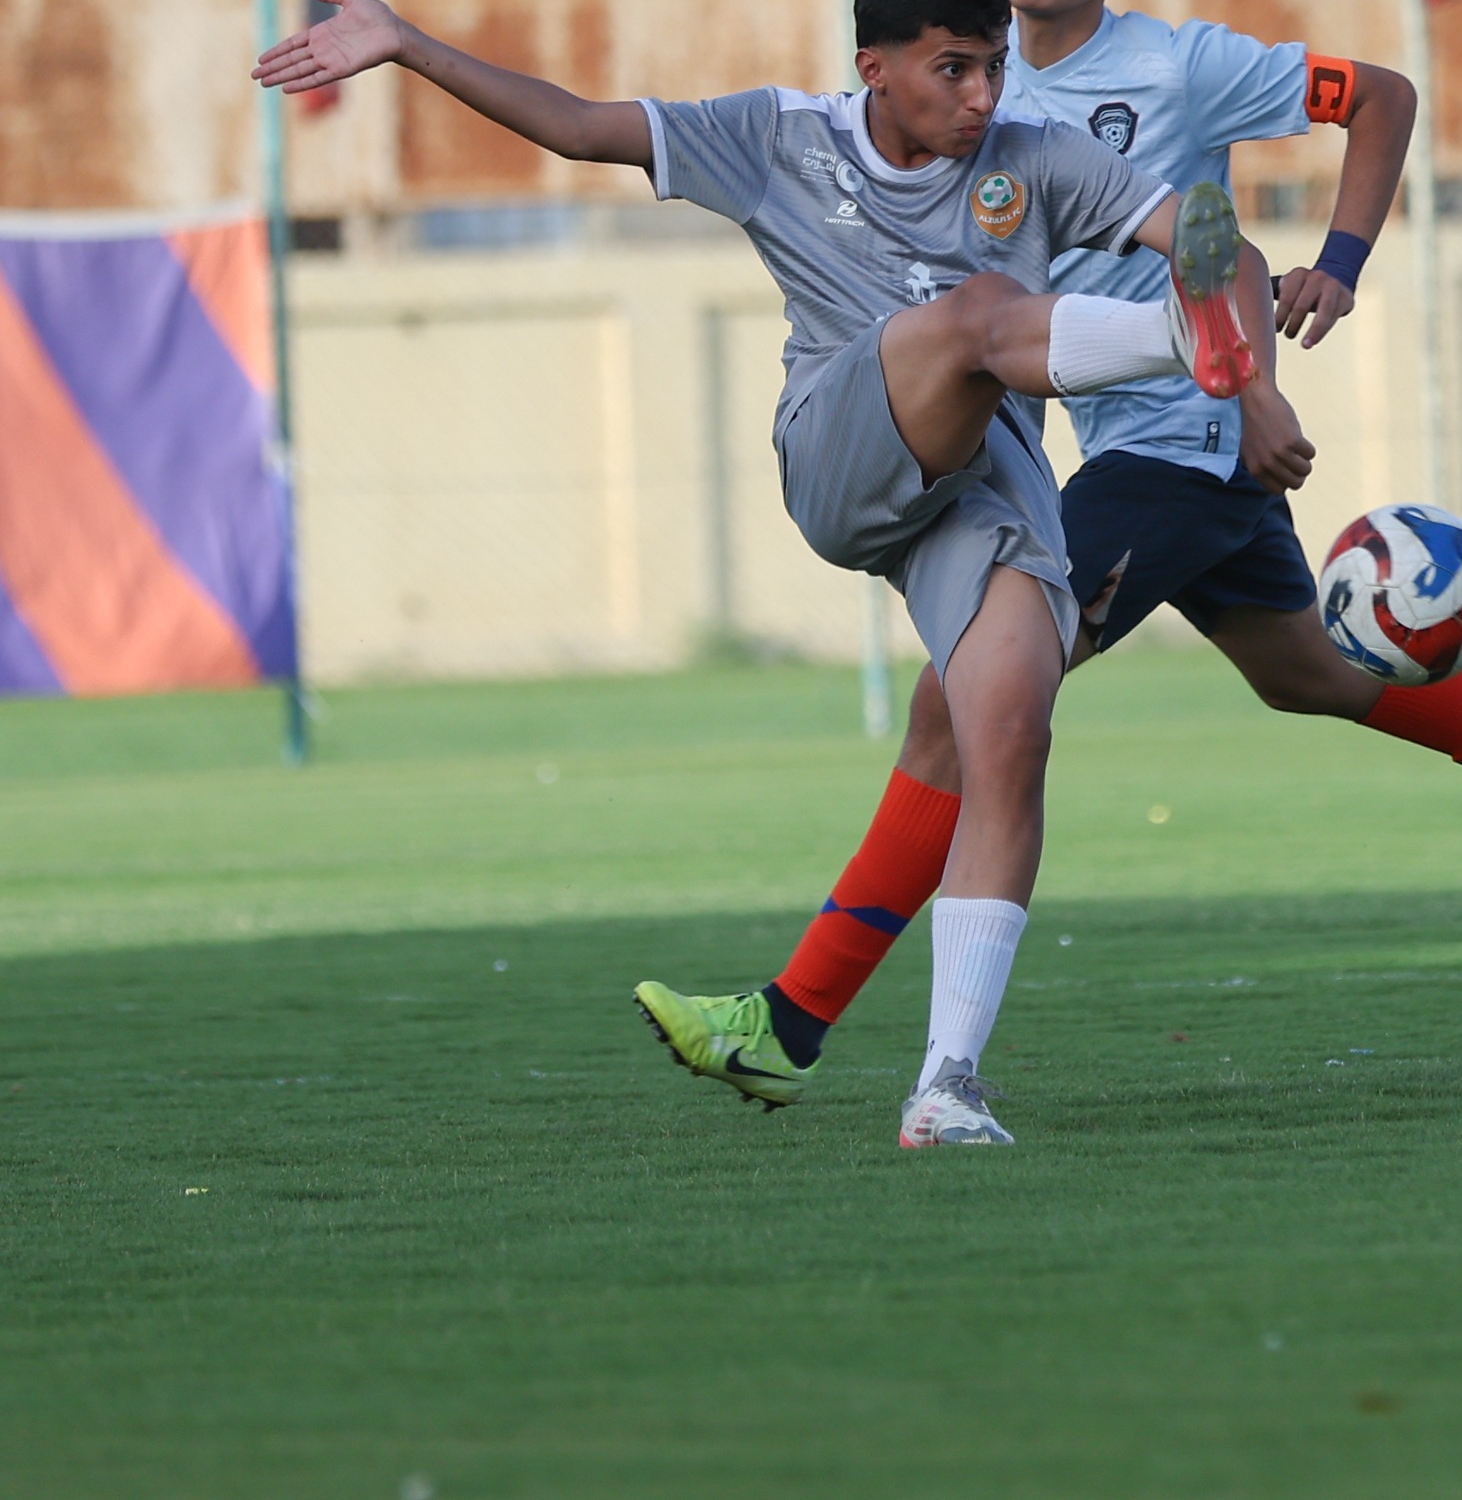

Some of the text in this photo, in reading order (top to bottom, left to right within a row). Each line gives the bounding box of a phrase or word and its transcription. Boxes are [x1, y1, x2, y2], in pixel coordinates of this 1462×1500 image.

[1310, 67, 1346, 110] C
[804, 147, 836, 164] cherry
[824, 217, 865, 227] HATTRICK
